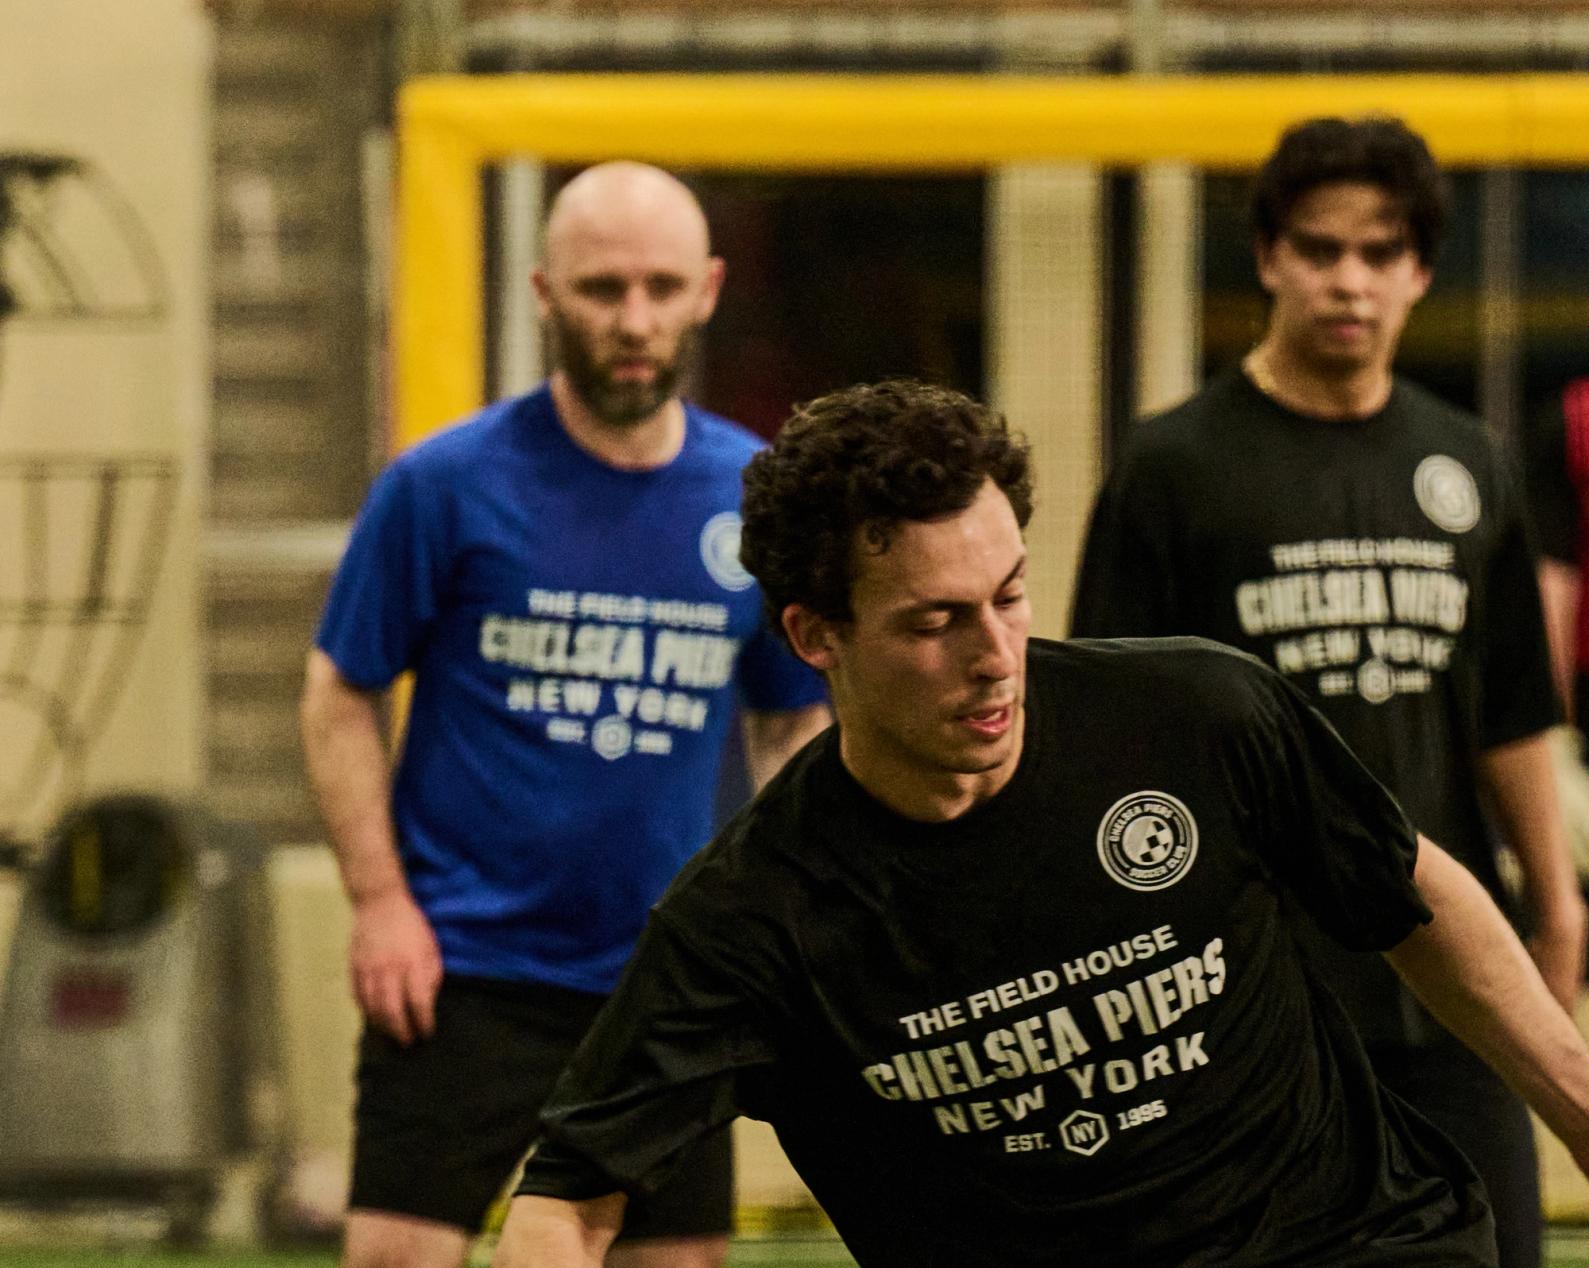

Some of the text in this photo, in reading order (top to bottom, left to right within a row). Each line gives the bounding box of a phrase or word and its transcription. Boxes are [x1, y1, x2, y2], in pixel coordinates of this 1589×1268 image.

[1275, 630, 1359, 672] NEW
[507, 679, 707, 731] NEW YORK
[861, 937, 1227, 1101] CHELSEA PIERS
[899, 924, 1179, 1040] THE FIELD HOUSE
[933, 1031, 1210, 1136] NEW YORK
[1005, 1098, 1169, 1153] EST. NY 1995
